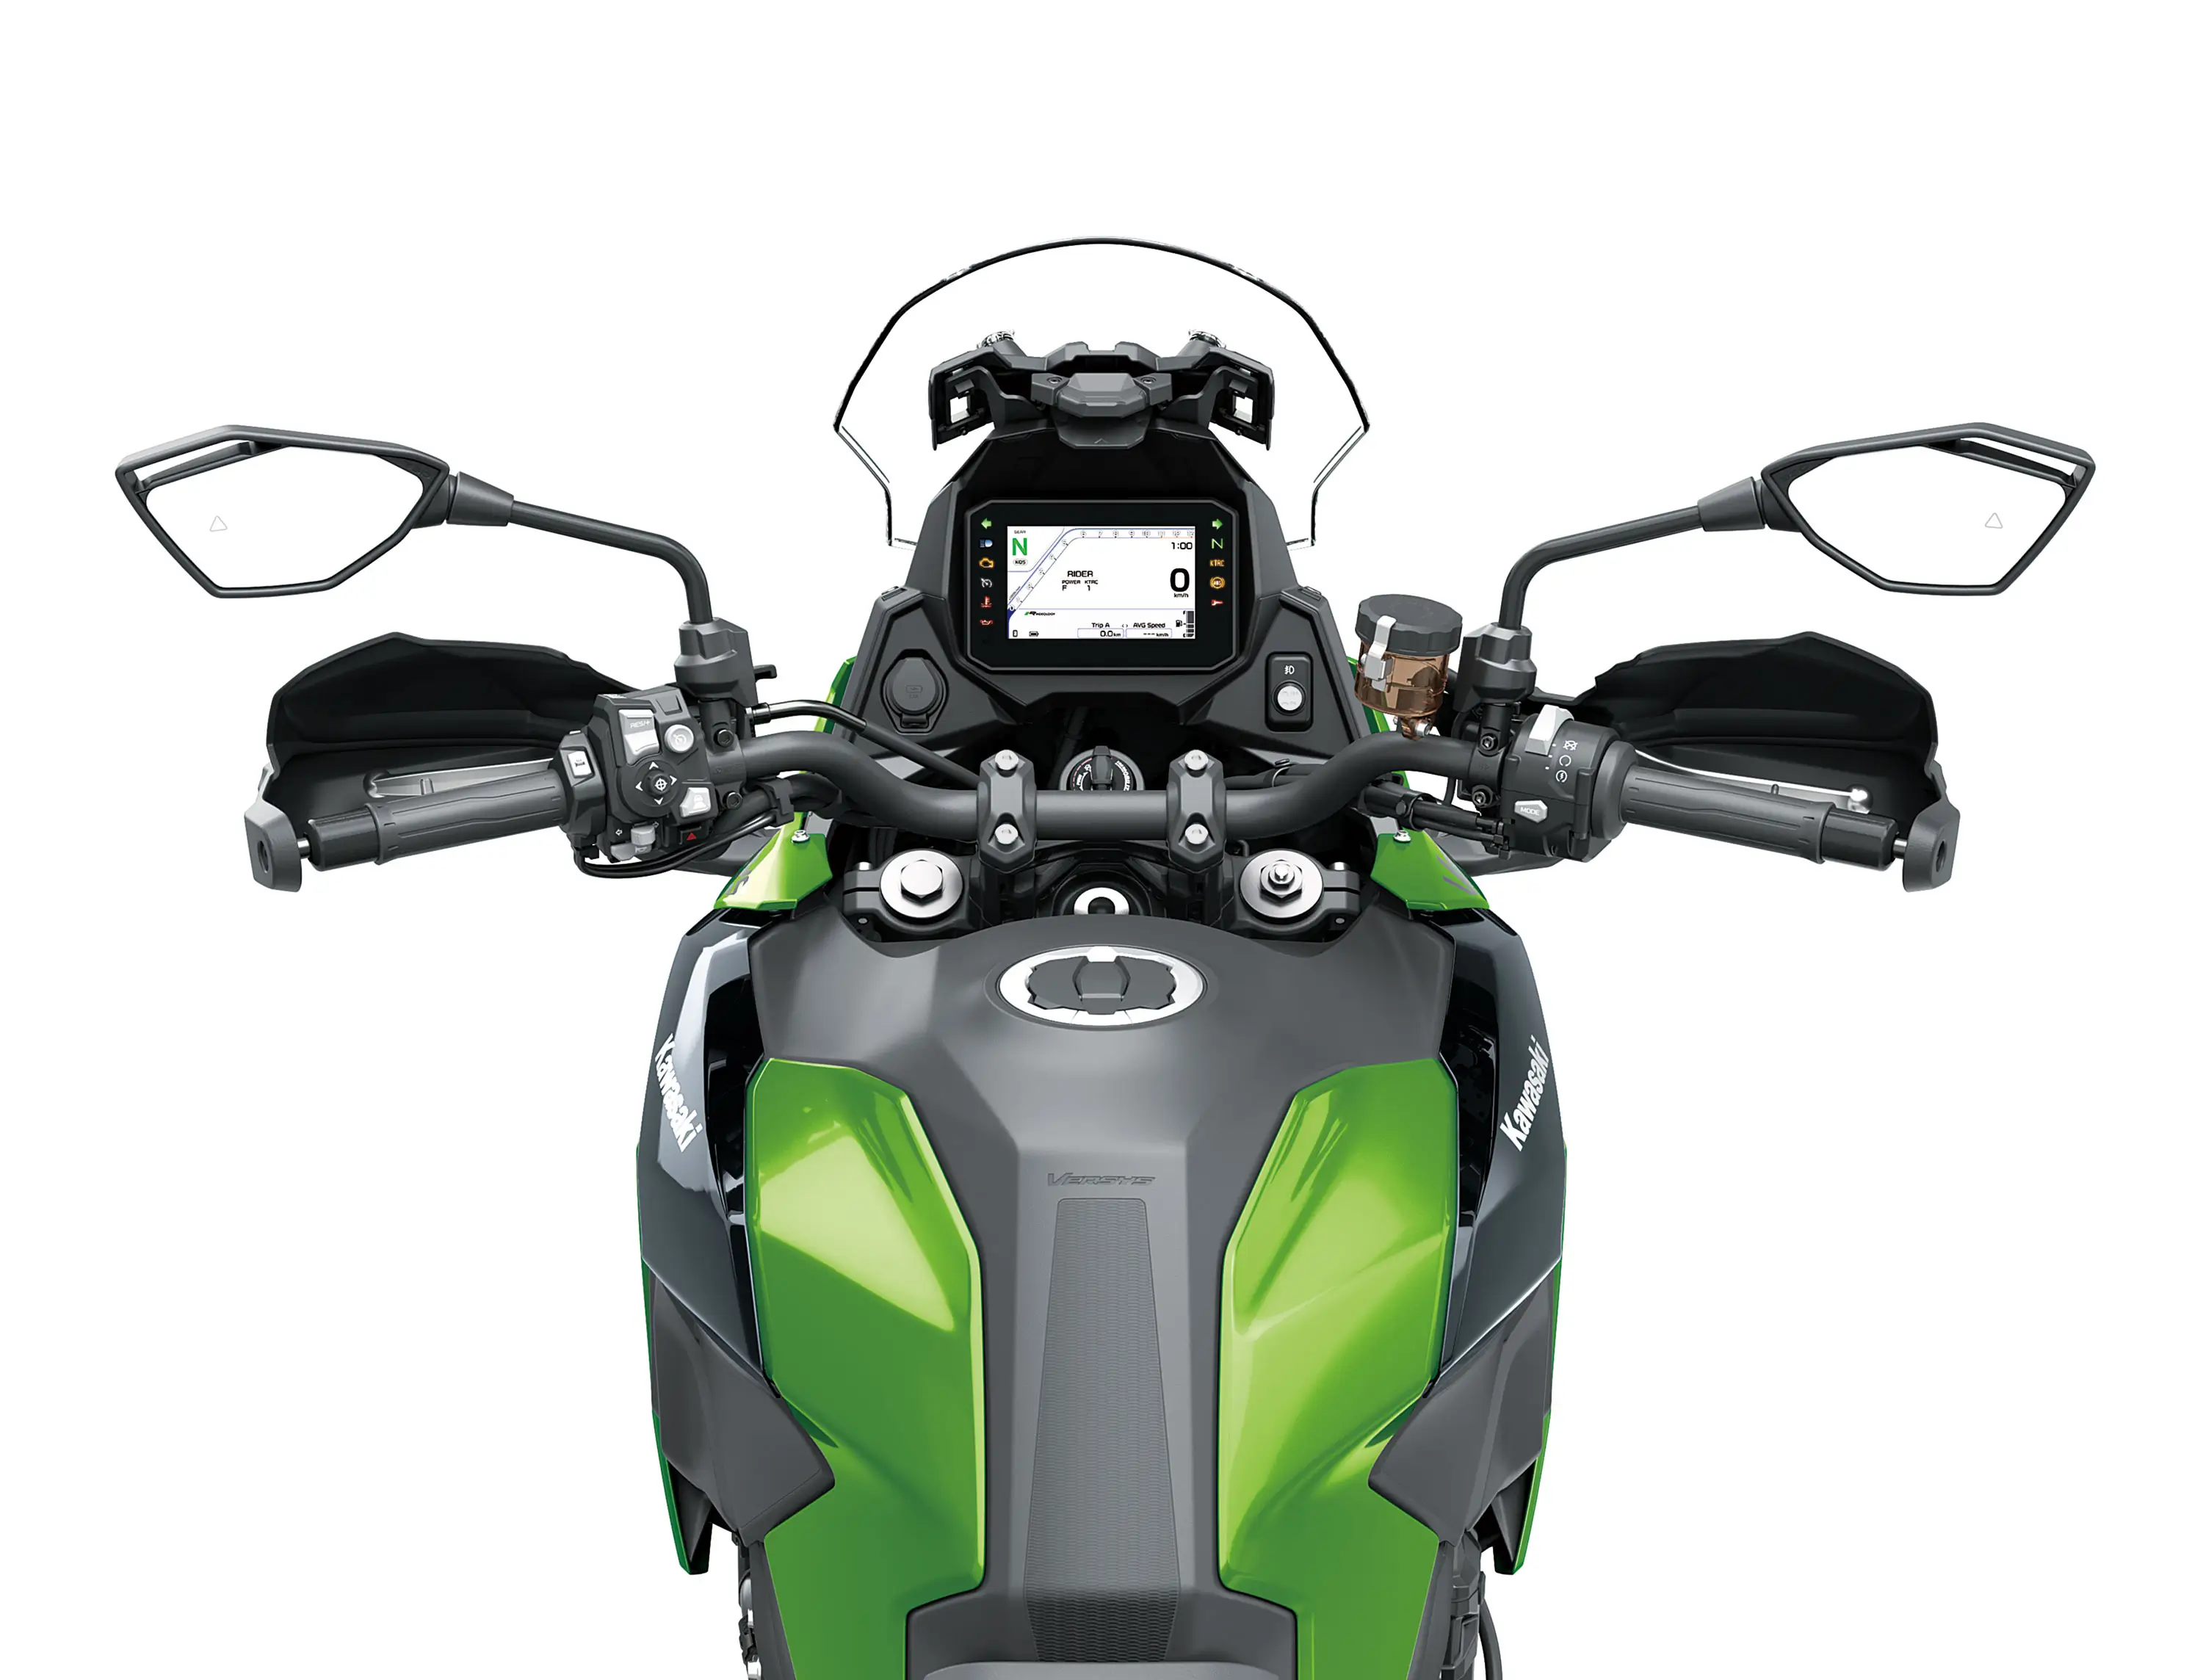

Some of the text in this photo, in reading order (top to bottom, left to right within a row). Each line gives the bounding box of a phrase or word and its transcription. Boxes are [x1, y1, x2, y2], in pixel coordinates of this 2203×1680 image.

[1012, 537, 1027, 556] N
[1171, 542, 1193, 550] 1:00
[1211, 537, 1223, 549] N
[1170, 568, 1190, 592] 0
[1520, 807, 1540, 816] MODE
[655, 1032, 703, 1153] Kawasaki
[1500, 1035, 1549, 1151] Kawasaki
[1047, 1172, 1156, 1186] VERSYS
